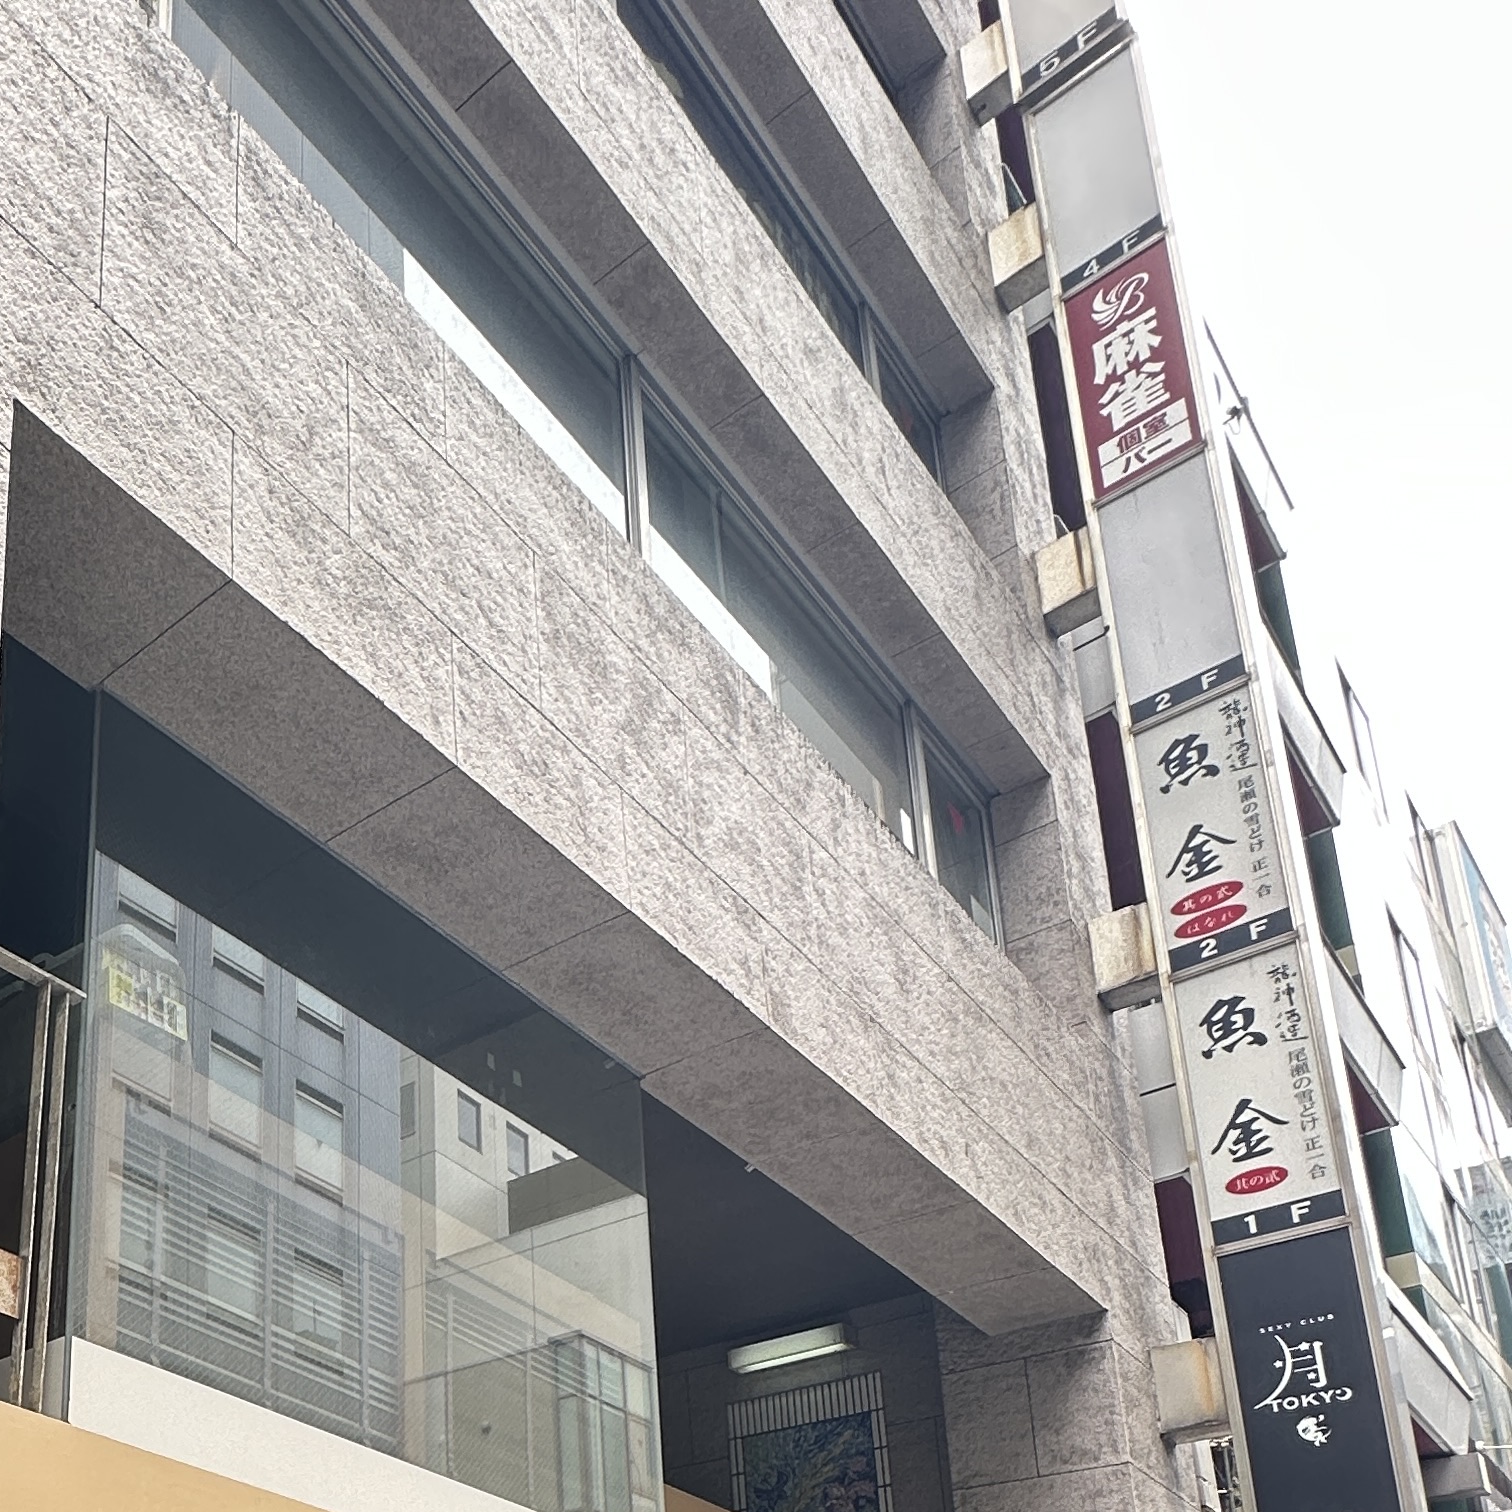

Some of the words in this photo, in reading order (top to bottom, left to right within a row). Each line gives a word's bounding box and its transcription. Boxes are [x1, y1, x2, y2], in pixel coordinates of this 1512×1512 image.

[1092, 306, 1170, 432] 麻雀
[1122, 437, 1173, 474] バー
[1157, 733, 1237, 883] 魚金
[1199, 995, 1289, 1163] 魚金
[1253, 1334, 1327, 1410] 月
[1268, 1386, 1353, 1412] TOKYO
